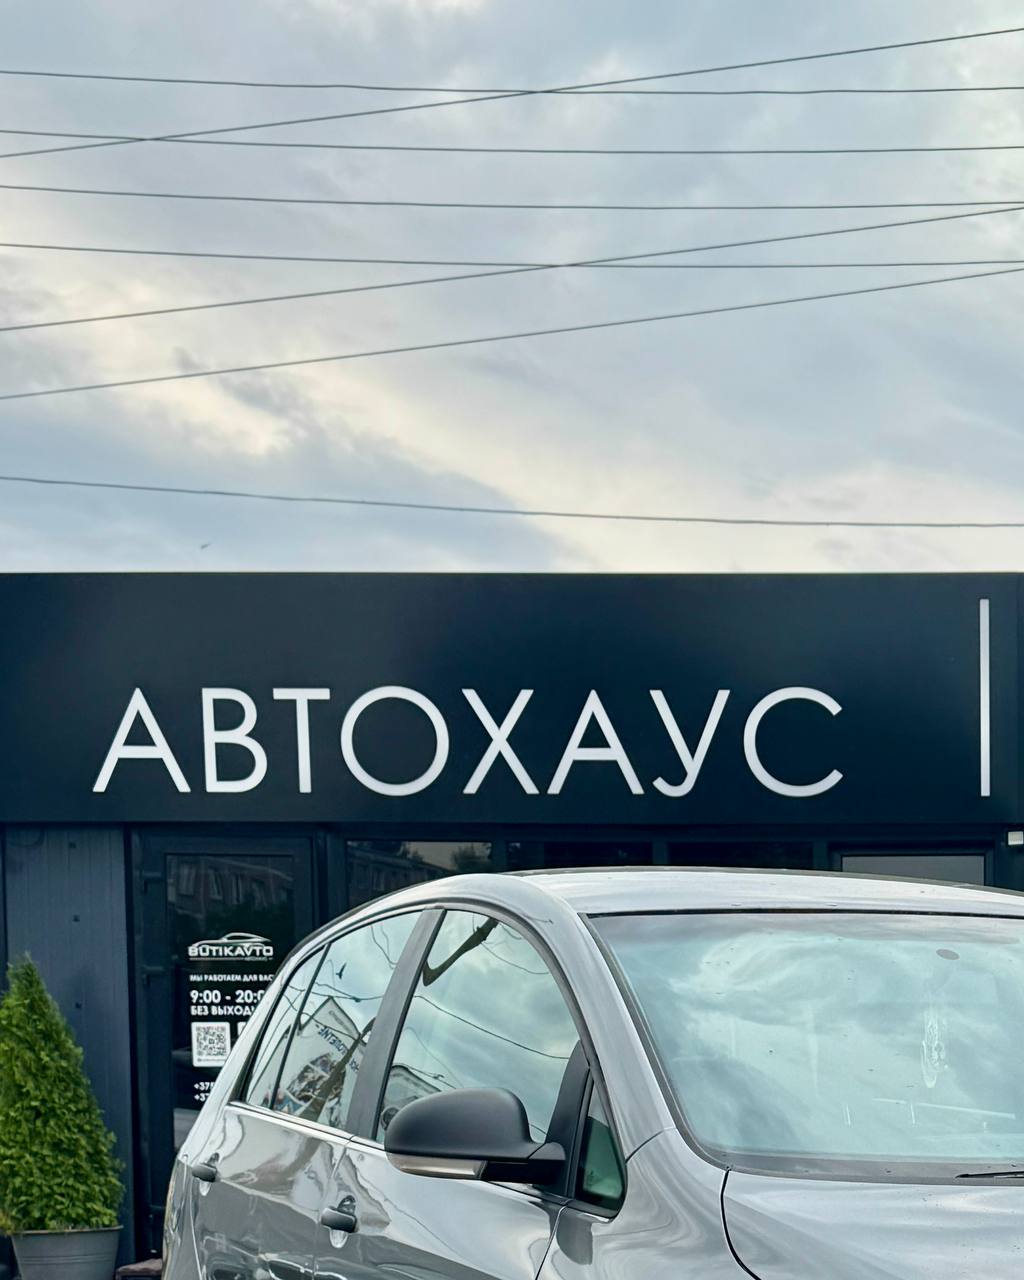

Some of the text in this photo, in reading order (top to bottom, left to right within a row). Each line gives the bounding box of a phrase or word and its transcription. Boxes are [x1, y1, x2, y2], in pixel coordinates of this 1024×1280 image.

[92, 684, 844, 798] АВТОХАУС
[188, 945, 274, 957] BUTIKAVTO
[189, 974, 203, 982] МЫ
[204, 974, 242, 982] РАБОТАЕМ
[190, 990, 221, 1004] 9:00
[190, 1005, 256, 1016] БЕЗ ВЫХОД
